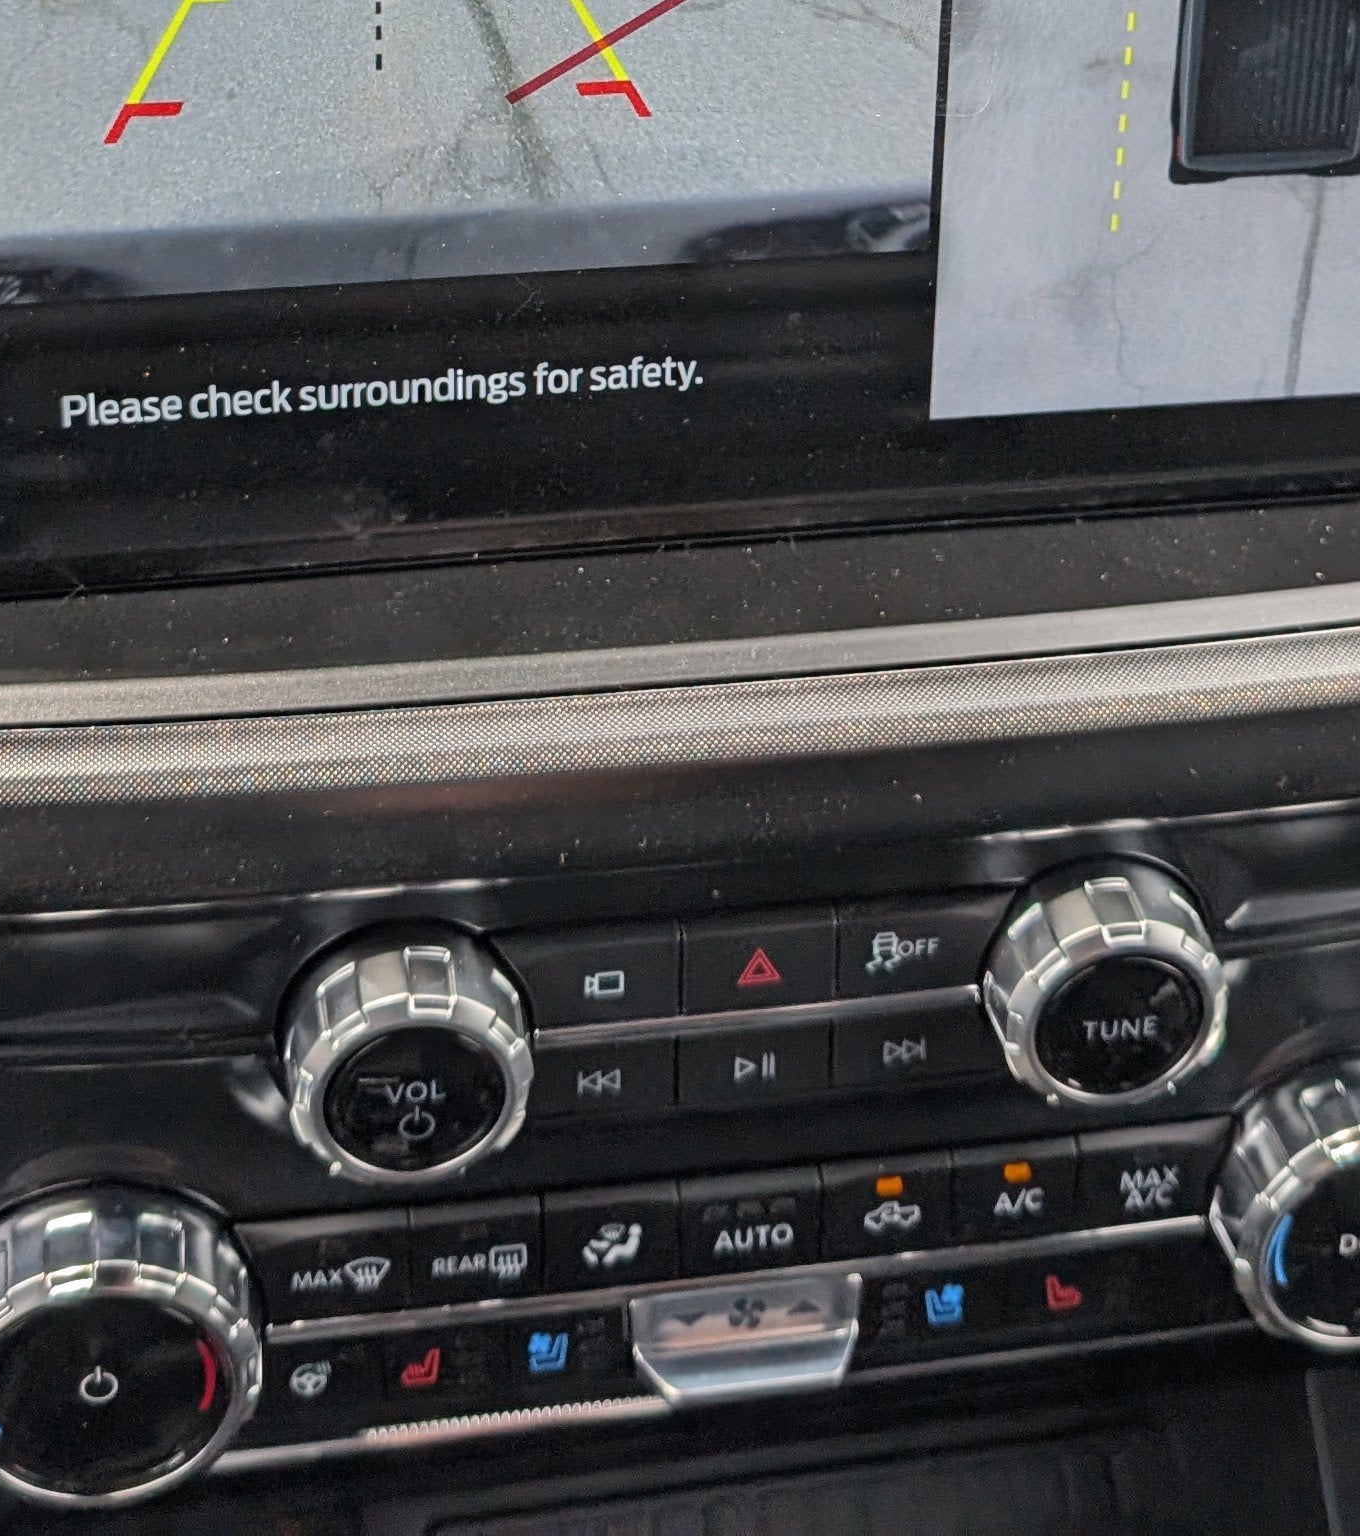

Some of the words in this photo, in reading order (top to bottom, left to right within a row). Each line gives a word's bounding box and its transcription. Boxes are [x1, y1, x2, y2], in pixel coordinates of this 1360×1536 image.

[60, 391, 182, 429] Please
[189, 380, 292, 420] check
[298, 366, 526, 413] surroundings
[534, 362, 584, 396] for
[589, 356, 704, 395] safety.
[896, 936, 940, 960] OFF
[1081, 1015, 1160, 1043] TUNE
[384, 1079, 446, 1105] VOL
[1119, 1166, 1179, 1193] MAX
[993, 1187, 1044, 1216] A/C
[1124, 1184, 1173, 1211] A/C
[713, 1222, 795, 1254] AUTO
[290, 1266, 342, 1290] MAX
[431, 1252, 487, 1278] REAR
